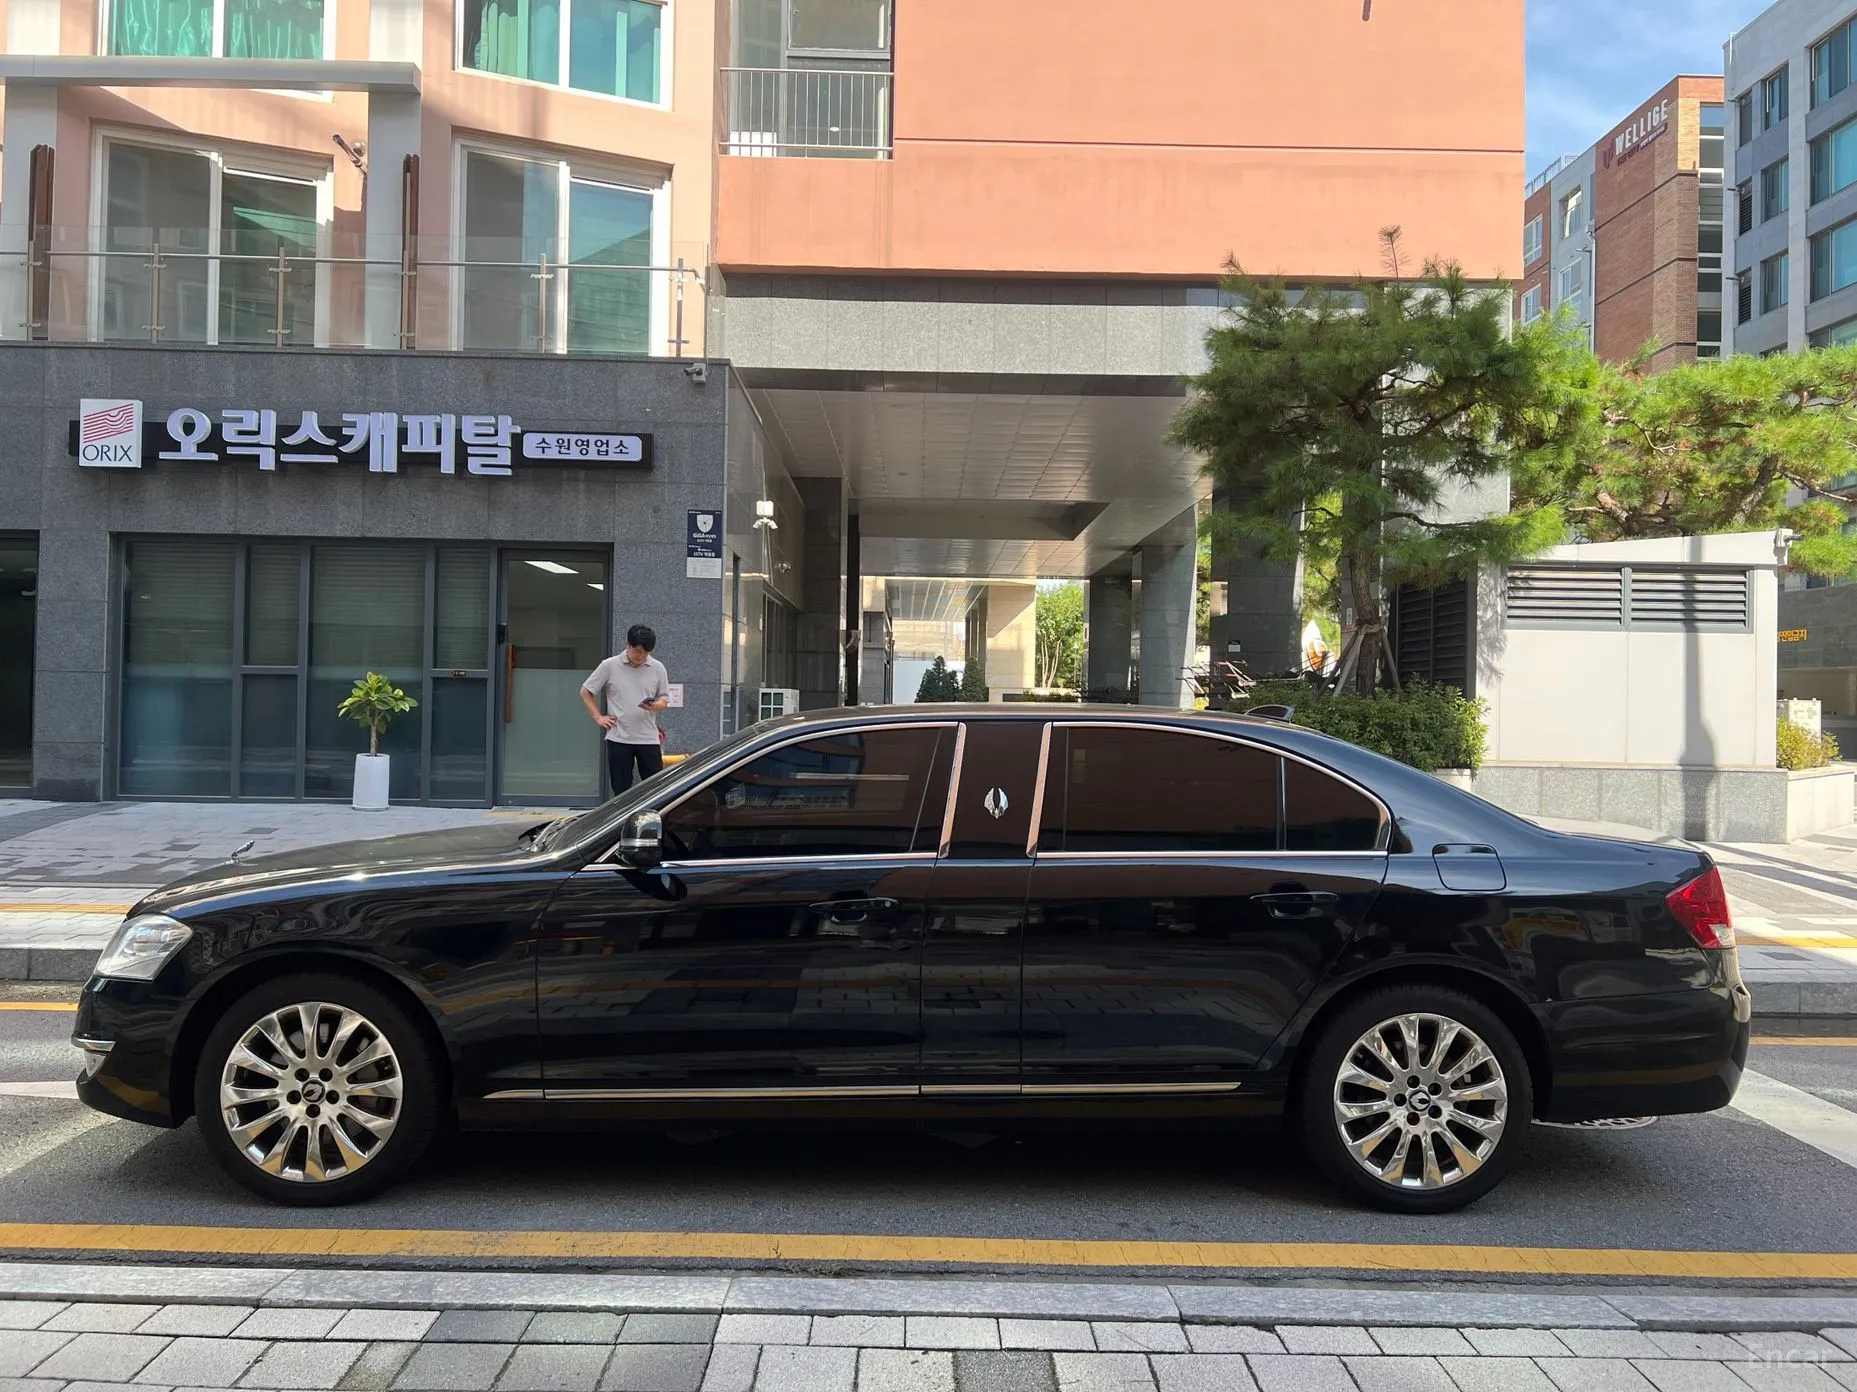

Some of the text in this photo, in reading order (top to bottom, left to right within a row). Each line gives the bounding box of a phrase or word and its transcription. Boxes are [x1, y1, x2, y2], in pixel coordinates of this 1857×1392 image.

[1615, 98, 1668, 156] WELLIGE
[82, 444, 133, 462] ORIX
[158, 407, 522, 476] 오릭스캐피탈
[535, 437, 630, 456] 수원영업소
